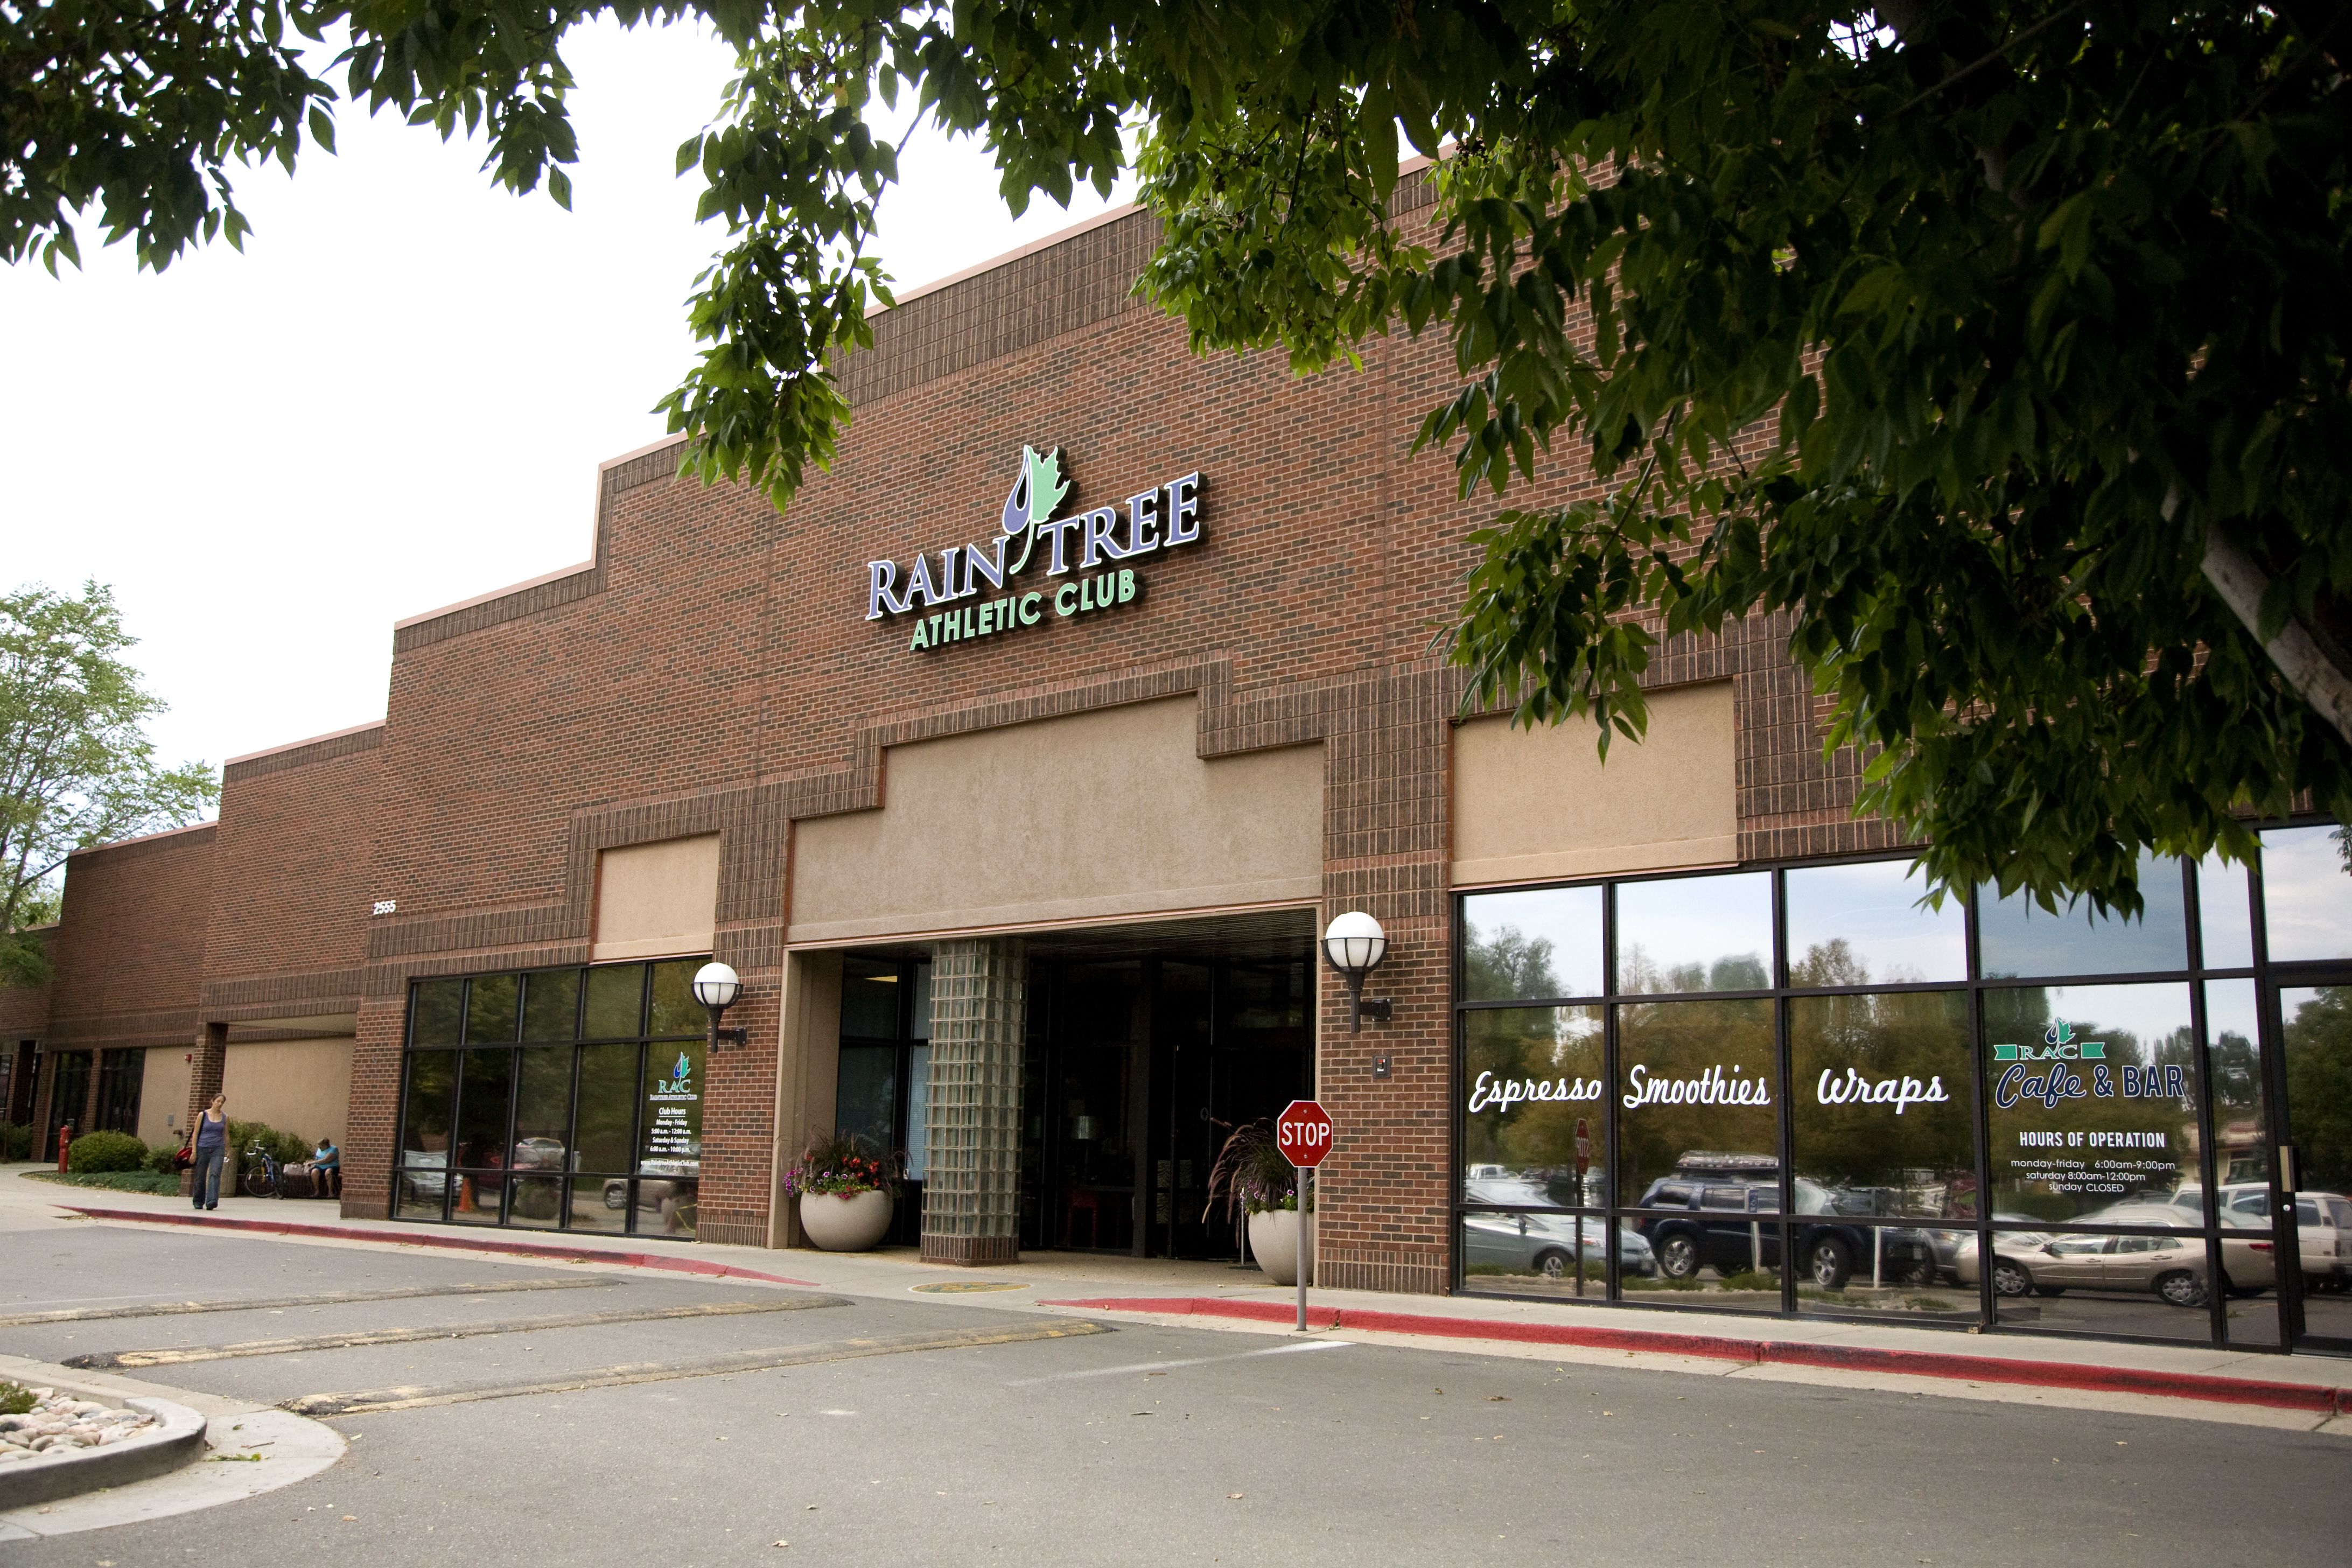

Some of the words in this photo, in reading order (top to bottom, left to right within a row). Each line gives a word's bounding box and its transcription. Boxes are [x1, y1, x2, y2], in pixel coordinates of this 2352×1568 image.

[909, 591, 1042, 651] ATHLETIC
[1055, 569, 1136, 617] CLUB
[373, 899, 397, 915] 2555
[2019, 1044, 2078, 1060] RAC
[657, 1079, 691, 1094] RAC
[1468, 1070, 1602, 1113] Espresso
[1622, 1064, 1770, 1109] Smoothies
[1817, 1068, 1949, 1115] Wraps
[1995, 1062, 2087, 1109] Cafe
[2093, 1064, 2115, 1097] &
[2122, 1065, 2185, 1097] BAR
[674, 1137, 689, 1145] Sunday
[1281, 1122, 1330, 1146] STOP
[2019, 1131, 2063, 1147] HOURS
[2068, 1131, 2084, 1147] OF
[2089, 1132, 2165, 1147] OPERATION
[2011, 1159, 2085, 1169] monday-friday
[2095, 1160, 2175, 1171] 6:00am-9:00pm
[2026, 1171, 2066, 1181] saturday
[2068, 1171, 2145, 1182] 8:00am-12:00pm
[2049, 1183, 2082, 1192] sunday
[2086, 1184, 2124, 1192] CLOSED
